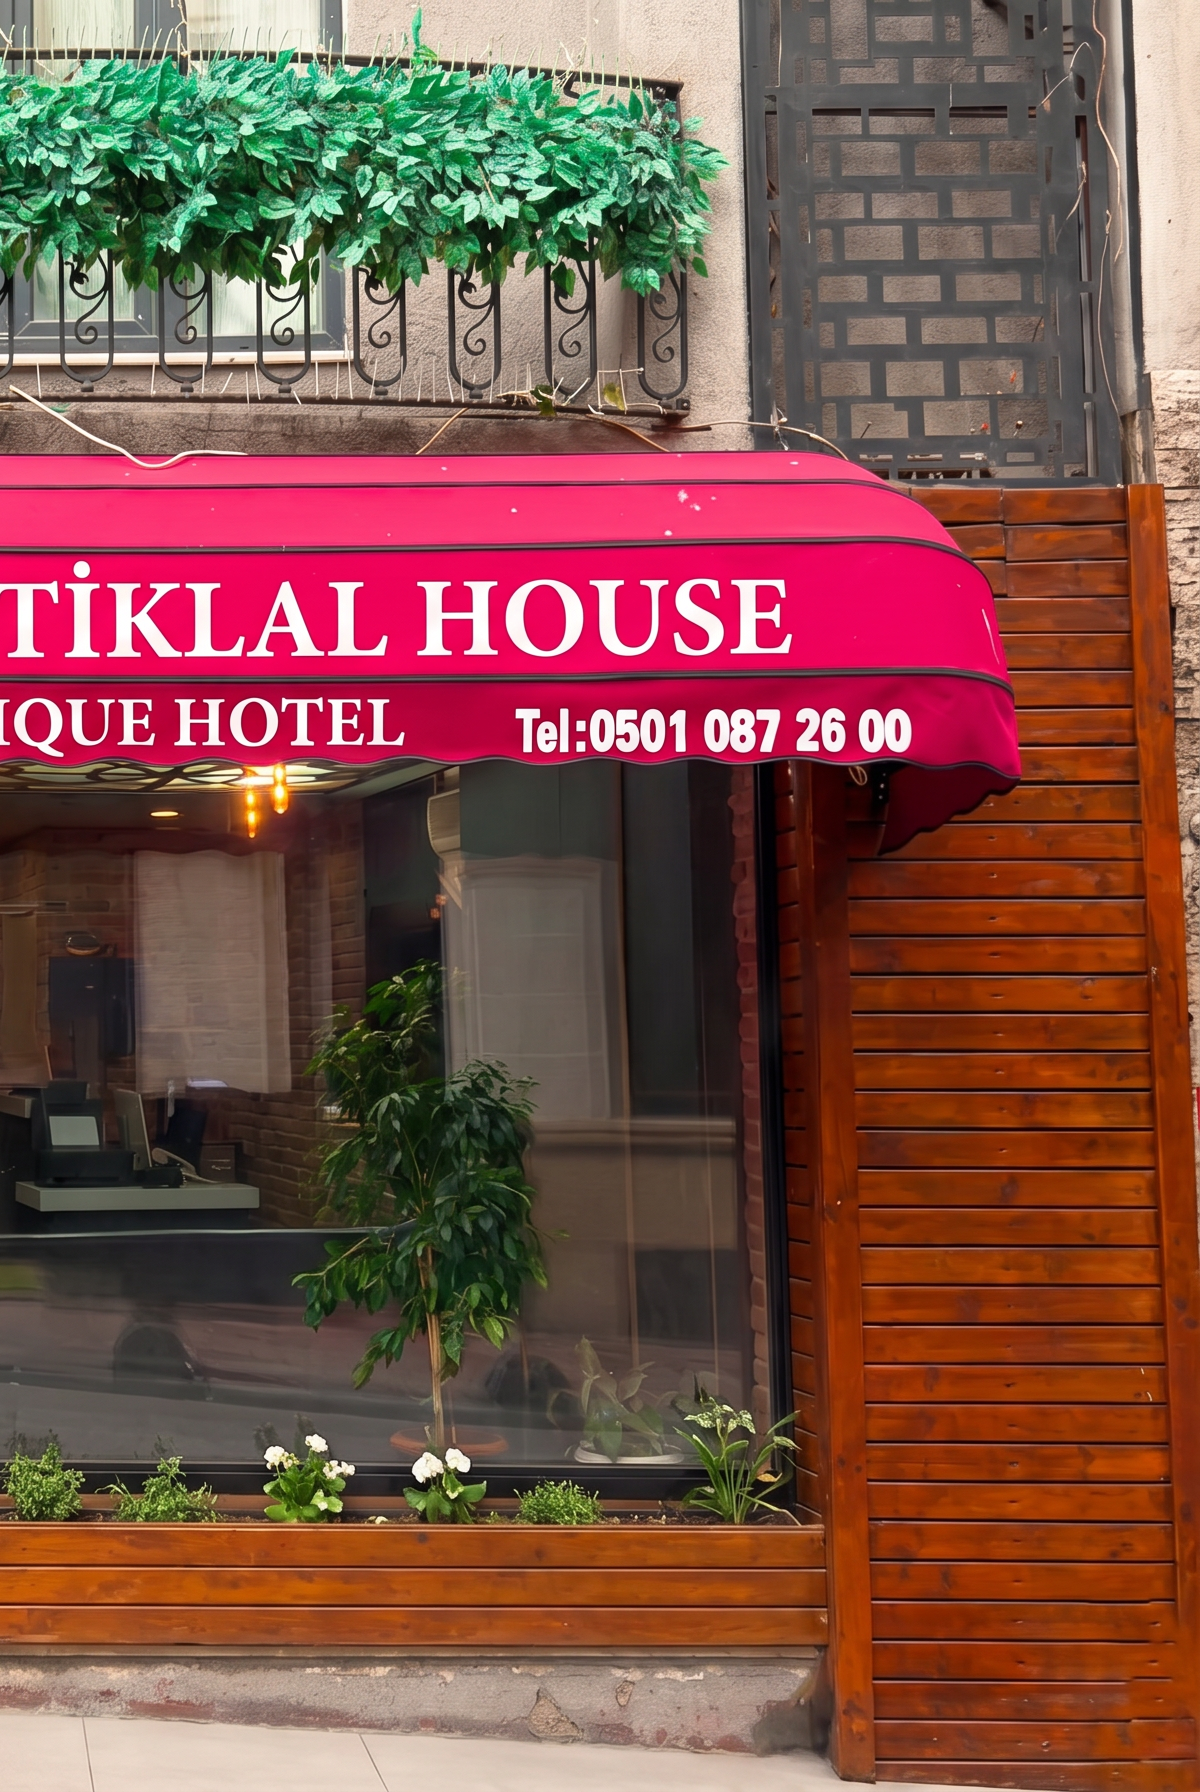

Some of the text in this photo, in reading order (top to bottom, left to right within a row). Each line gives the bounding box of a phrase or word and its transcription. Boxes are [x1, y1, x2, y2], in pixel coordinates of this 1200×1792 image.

[416, 578, 793, 657] HOUSE
[173, 697, 405, 747] HOTEL
[515, 708, 912, 753] Tel:0501 087 26 00
